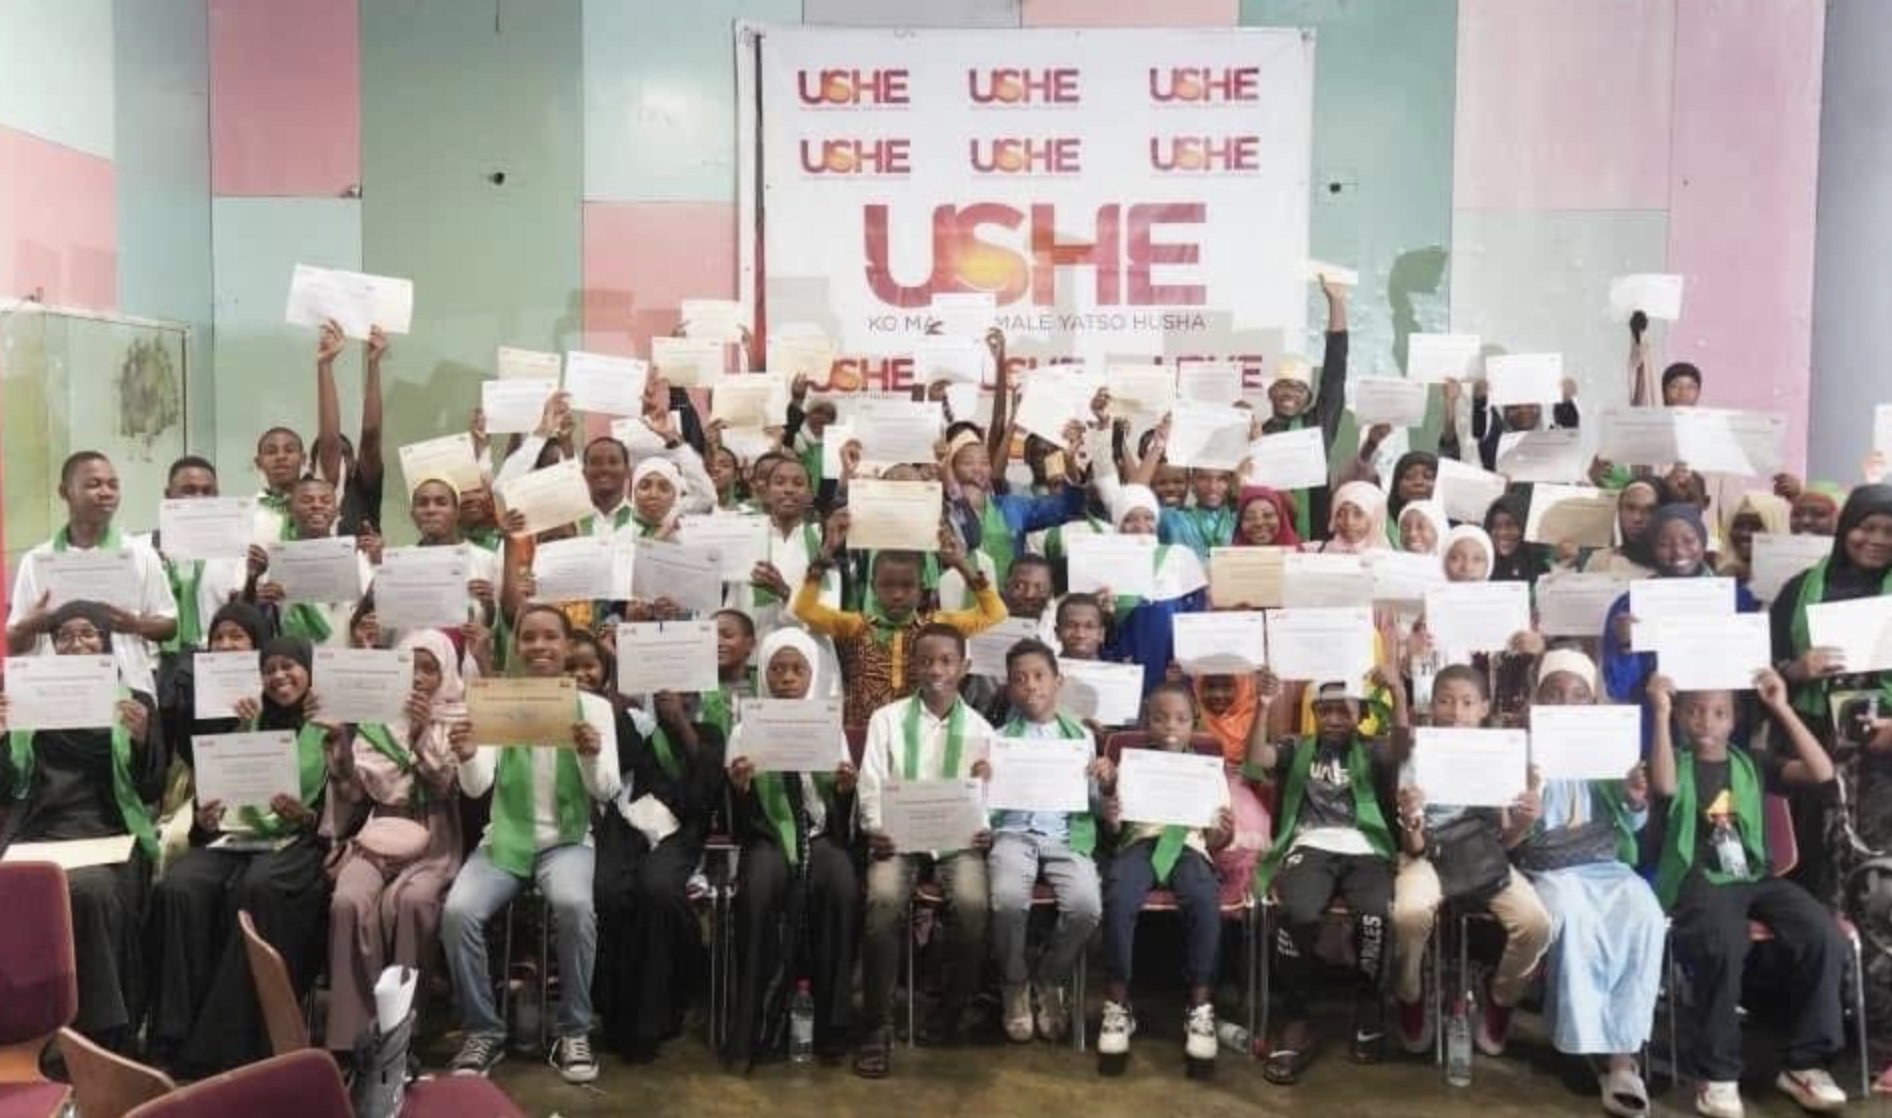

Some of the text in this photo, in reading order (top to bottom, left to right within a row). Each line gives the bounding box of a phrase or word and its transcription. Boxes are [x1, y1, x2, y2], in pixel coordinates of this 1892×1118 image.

[798, 70, 910, 104] USHE
[969, 69, 1080, 103] USHE
[1150, 67, 1259, 101] USHE
[801, 139, 911, 173] USHE
[971, 139, 1081, 173] USHE
[1151, 137, 1260, 171] USHE
[863, 202, 1206, 309] USHE
[868, 315, 898, 332] KO
[1057, 314, 1127, 331] YATSO
[1132, 313, 1206, 331] HUSHA
